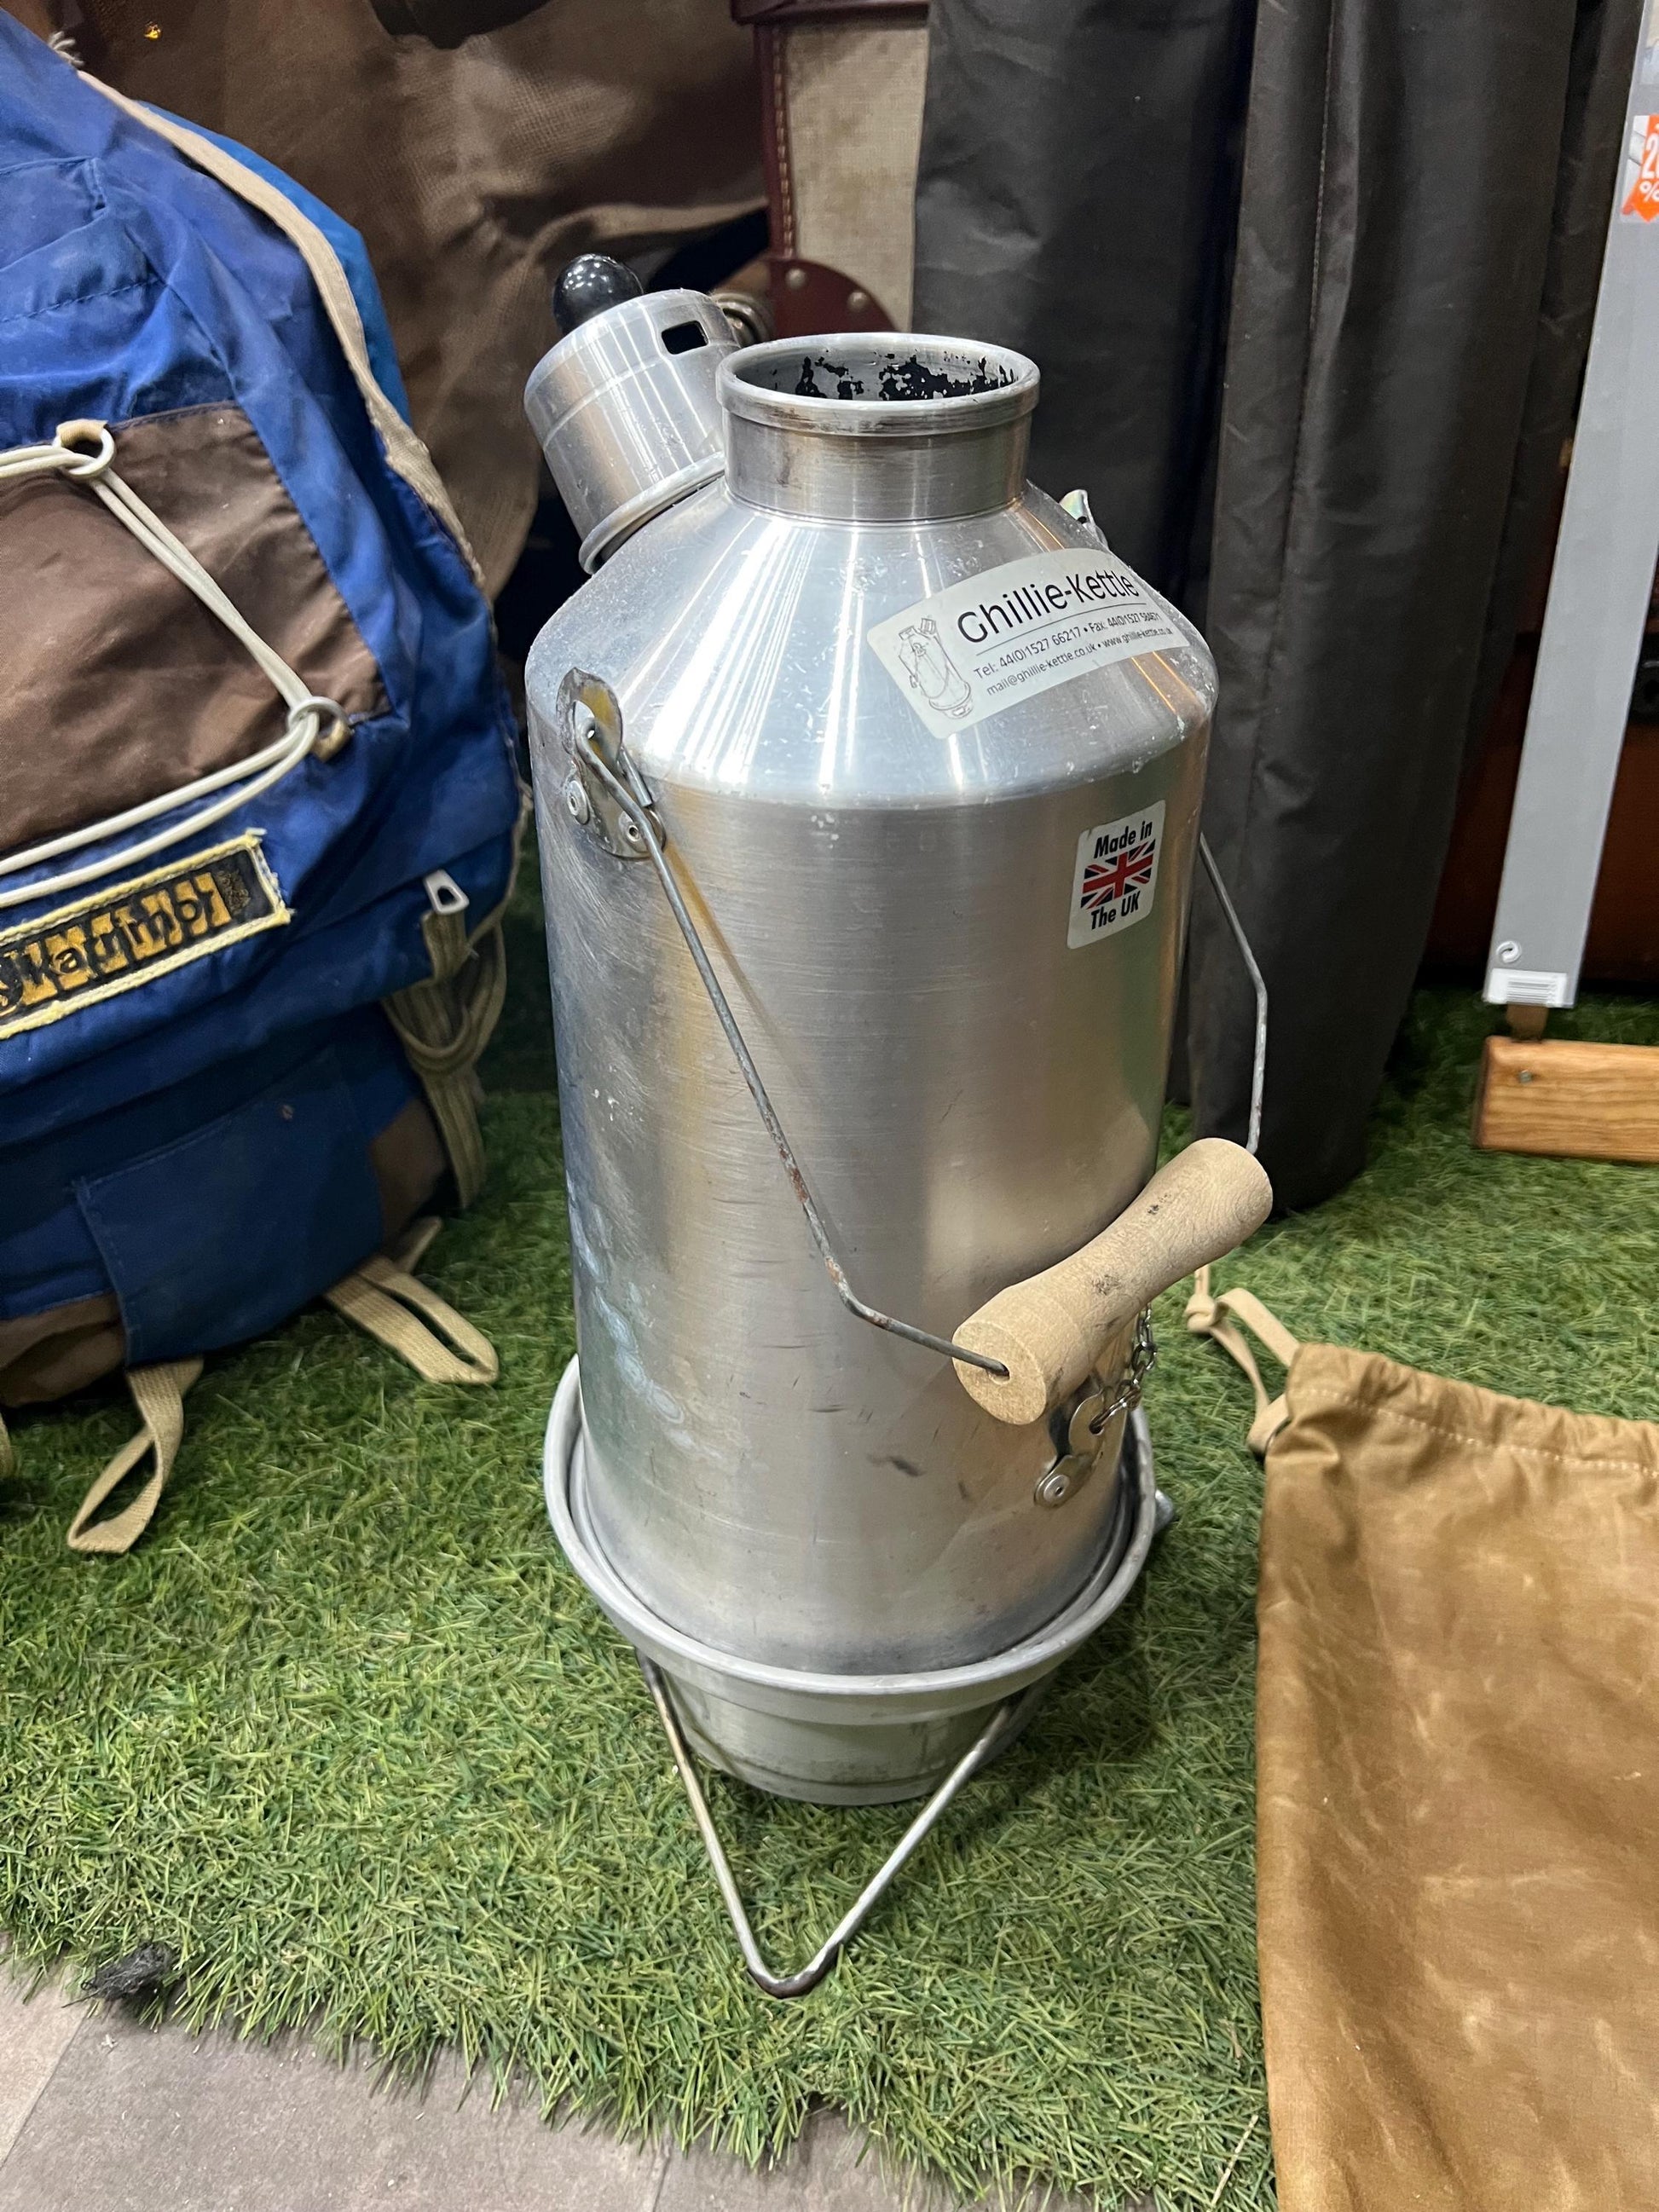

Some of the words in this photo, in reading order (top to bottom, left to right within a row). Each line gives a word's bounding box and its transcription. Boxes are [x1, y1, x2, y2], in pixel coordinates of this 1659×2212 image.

[1642, 133, 1659, 180] 2
[957, 569, 1140, 644] Ghillie-Kettle
[974, 662, 999, 679] Tel:
[999, 638, 1050, 667] 44(0)1527
[1051, 627, 1082, 646] 66217
[1088, 621, 1107, 633] Fax:
[986, 642, 1098, 696] mail@ghillie-kettle.co.uk
[1093, 825, 1137, 859] Made
[1140, 820, 1153, 840] in
[1090, 905, 1117, 931] The
[1120, 890, 1142, 917] UK
